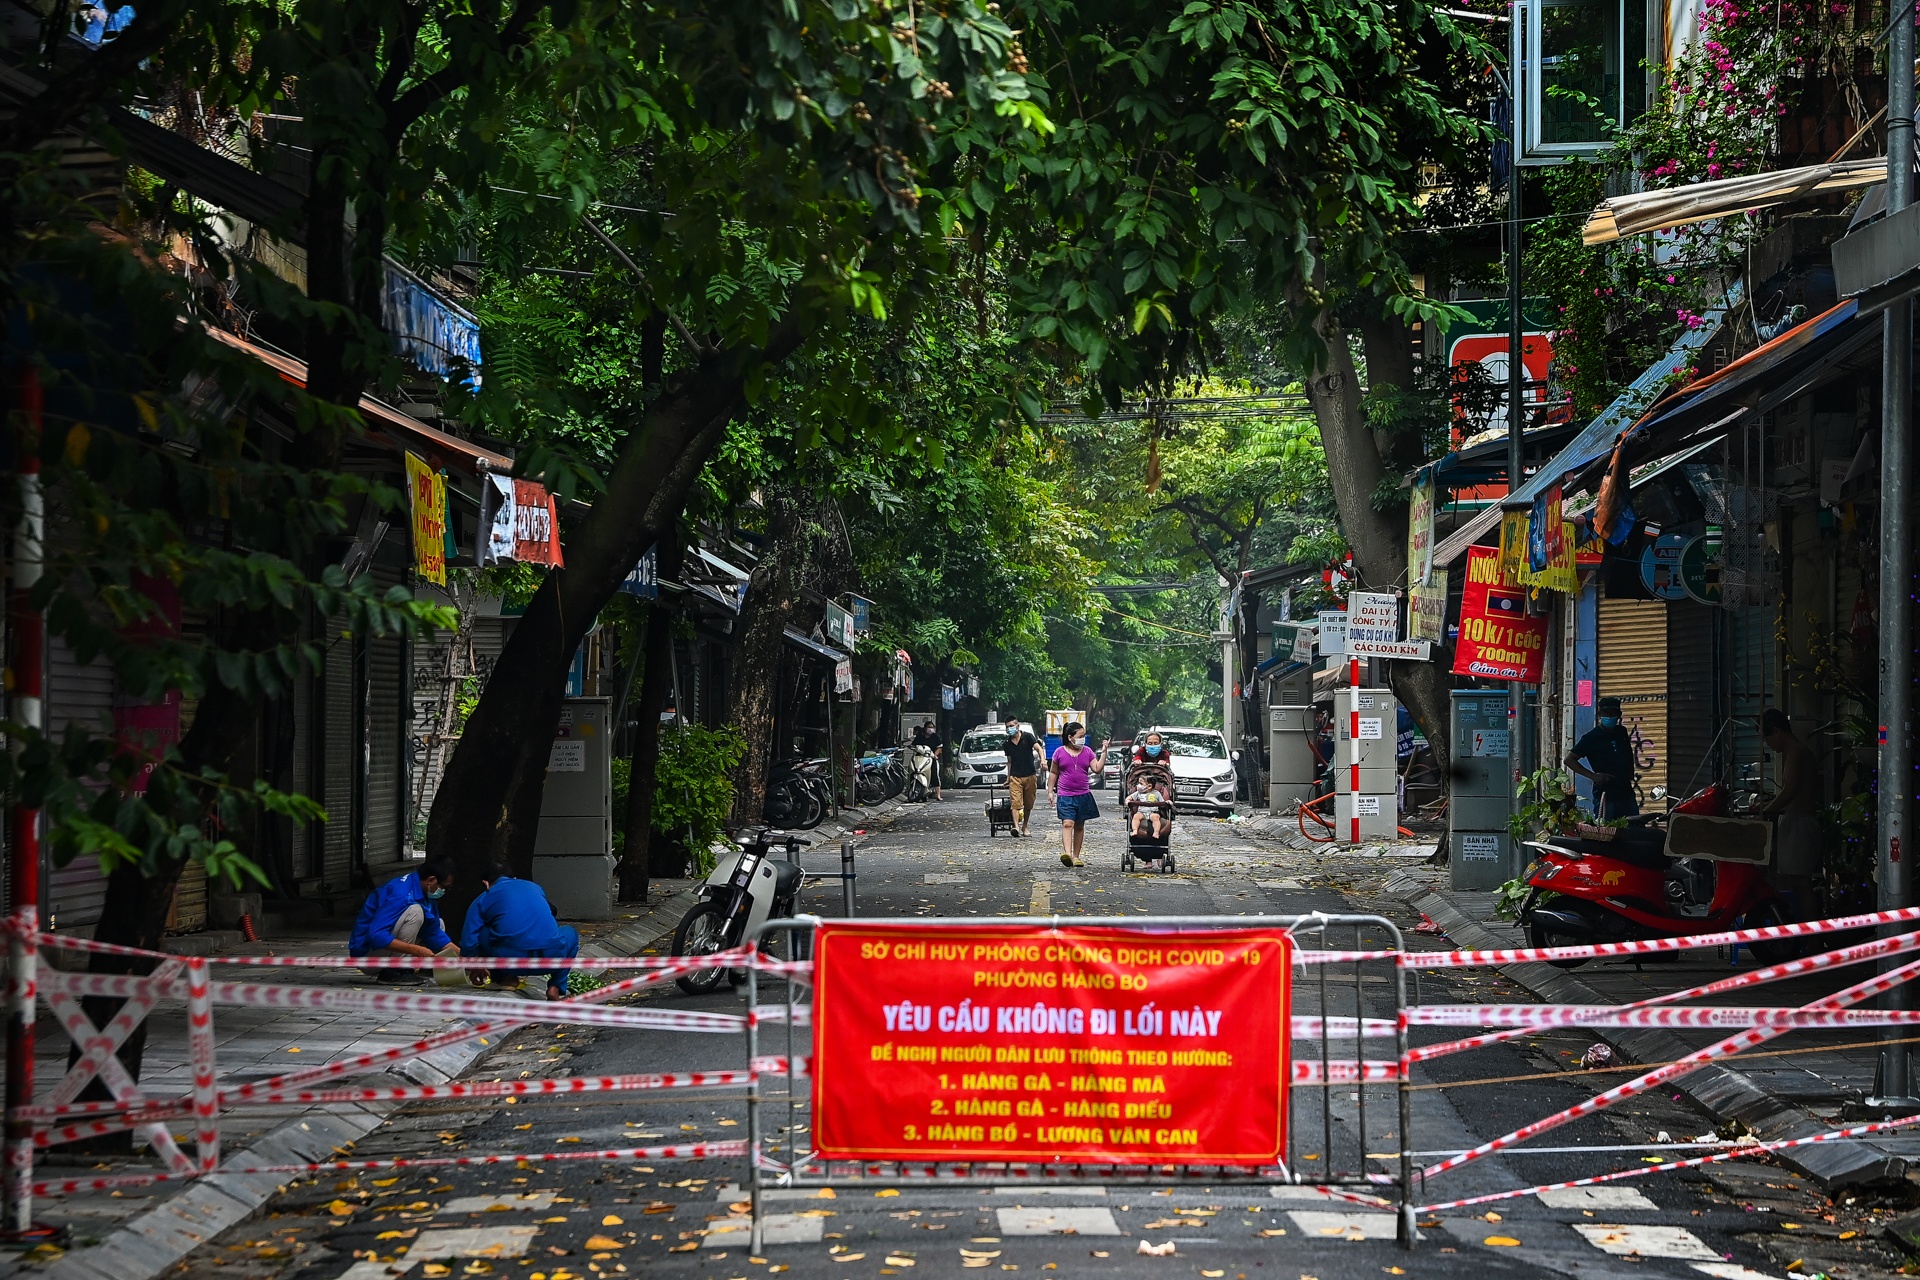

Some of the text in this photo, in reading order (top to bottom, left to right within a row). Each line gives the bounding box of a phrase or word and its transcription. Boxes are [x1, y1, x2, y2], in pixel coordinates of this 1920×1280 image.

[1353, 616, 1375, 626] CÔNG
[1354, 641, 1373, 652] CÁC
[1376, 645, 1398, 655] LOẠI
[1476, 645, 1527, 665] 700ml
[1469, 661, 1499, 675] Cảm
[861, 940, 890, 960] SỞ
[930, 945, 969, 961] HUY
[974, 942, 1041, 963] PHÒNG
[1117, 949, 1162, 968] DỊCH
[1166, 950, 1224, 967] COVID
[1241, 948, 1261, 967] 19
[973, 968, 1058, 989] PHƯỜNG
[1062, 970, 1115, 990] HÀNG
[882, 1000, 931, 1032] YÊU
[996, 1002, 1084, 1035] KHÔNG
[1090, 1008, 1116, 1036] ĐI
[1123, 1000, 1164, 1036] LỐI
[1169, 1004, 1222, 1037] NÀY
[896, 1045, 937, 1065] NGHỊ
[940, 1043, 992, 1063] NGƯỜI
[995, 1044, 1031, 1063] DÂN
[1033, 1046, 1066, 1064] LƯU
[1069, 1046, 1123, 1066] THÔNG
[1127, 1049, 1168, 1067] THEO
[1172, 1048, 1233, 1067] HƯỚNG:
[938, 1073, 957, 1091] 1.
[961, 1071, 1018, 1091] HÀNG
[1023, 1071, 1052, 1092] GÀ
[1071, 1073, 1127, 1094] HÀNG
[930, 1099, 950, 1116] 2.
[954, 1097, 1012, 1117] HÀNG
[1016, 1097, 1045, 1118] GÀ
[1064, 1098, 1120, 1119] HÀNG
[1125, 1098, 1172, 1120] ĐIẾU
[903, 1124, 922, 1142] 3.
[927, 1122, 984, 1143] HÀNG
[1036, 1126, 1104, 1144] LƯƠNG
[1109, 1125, 1150, 1145] VĂN
[1155, 1128, 1198, 1145] CAN
